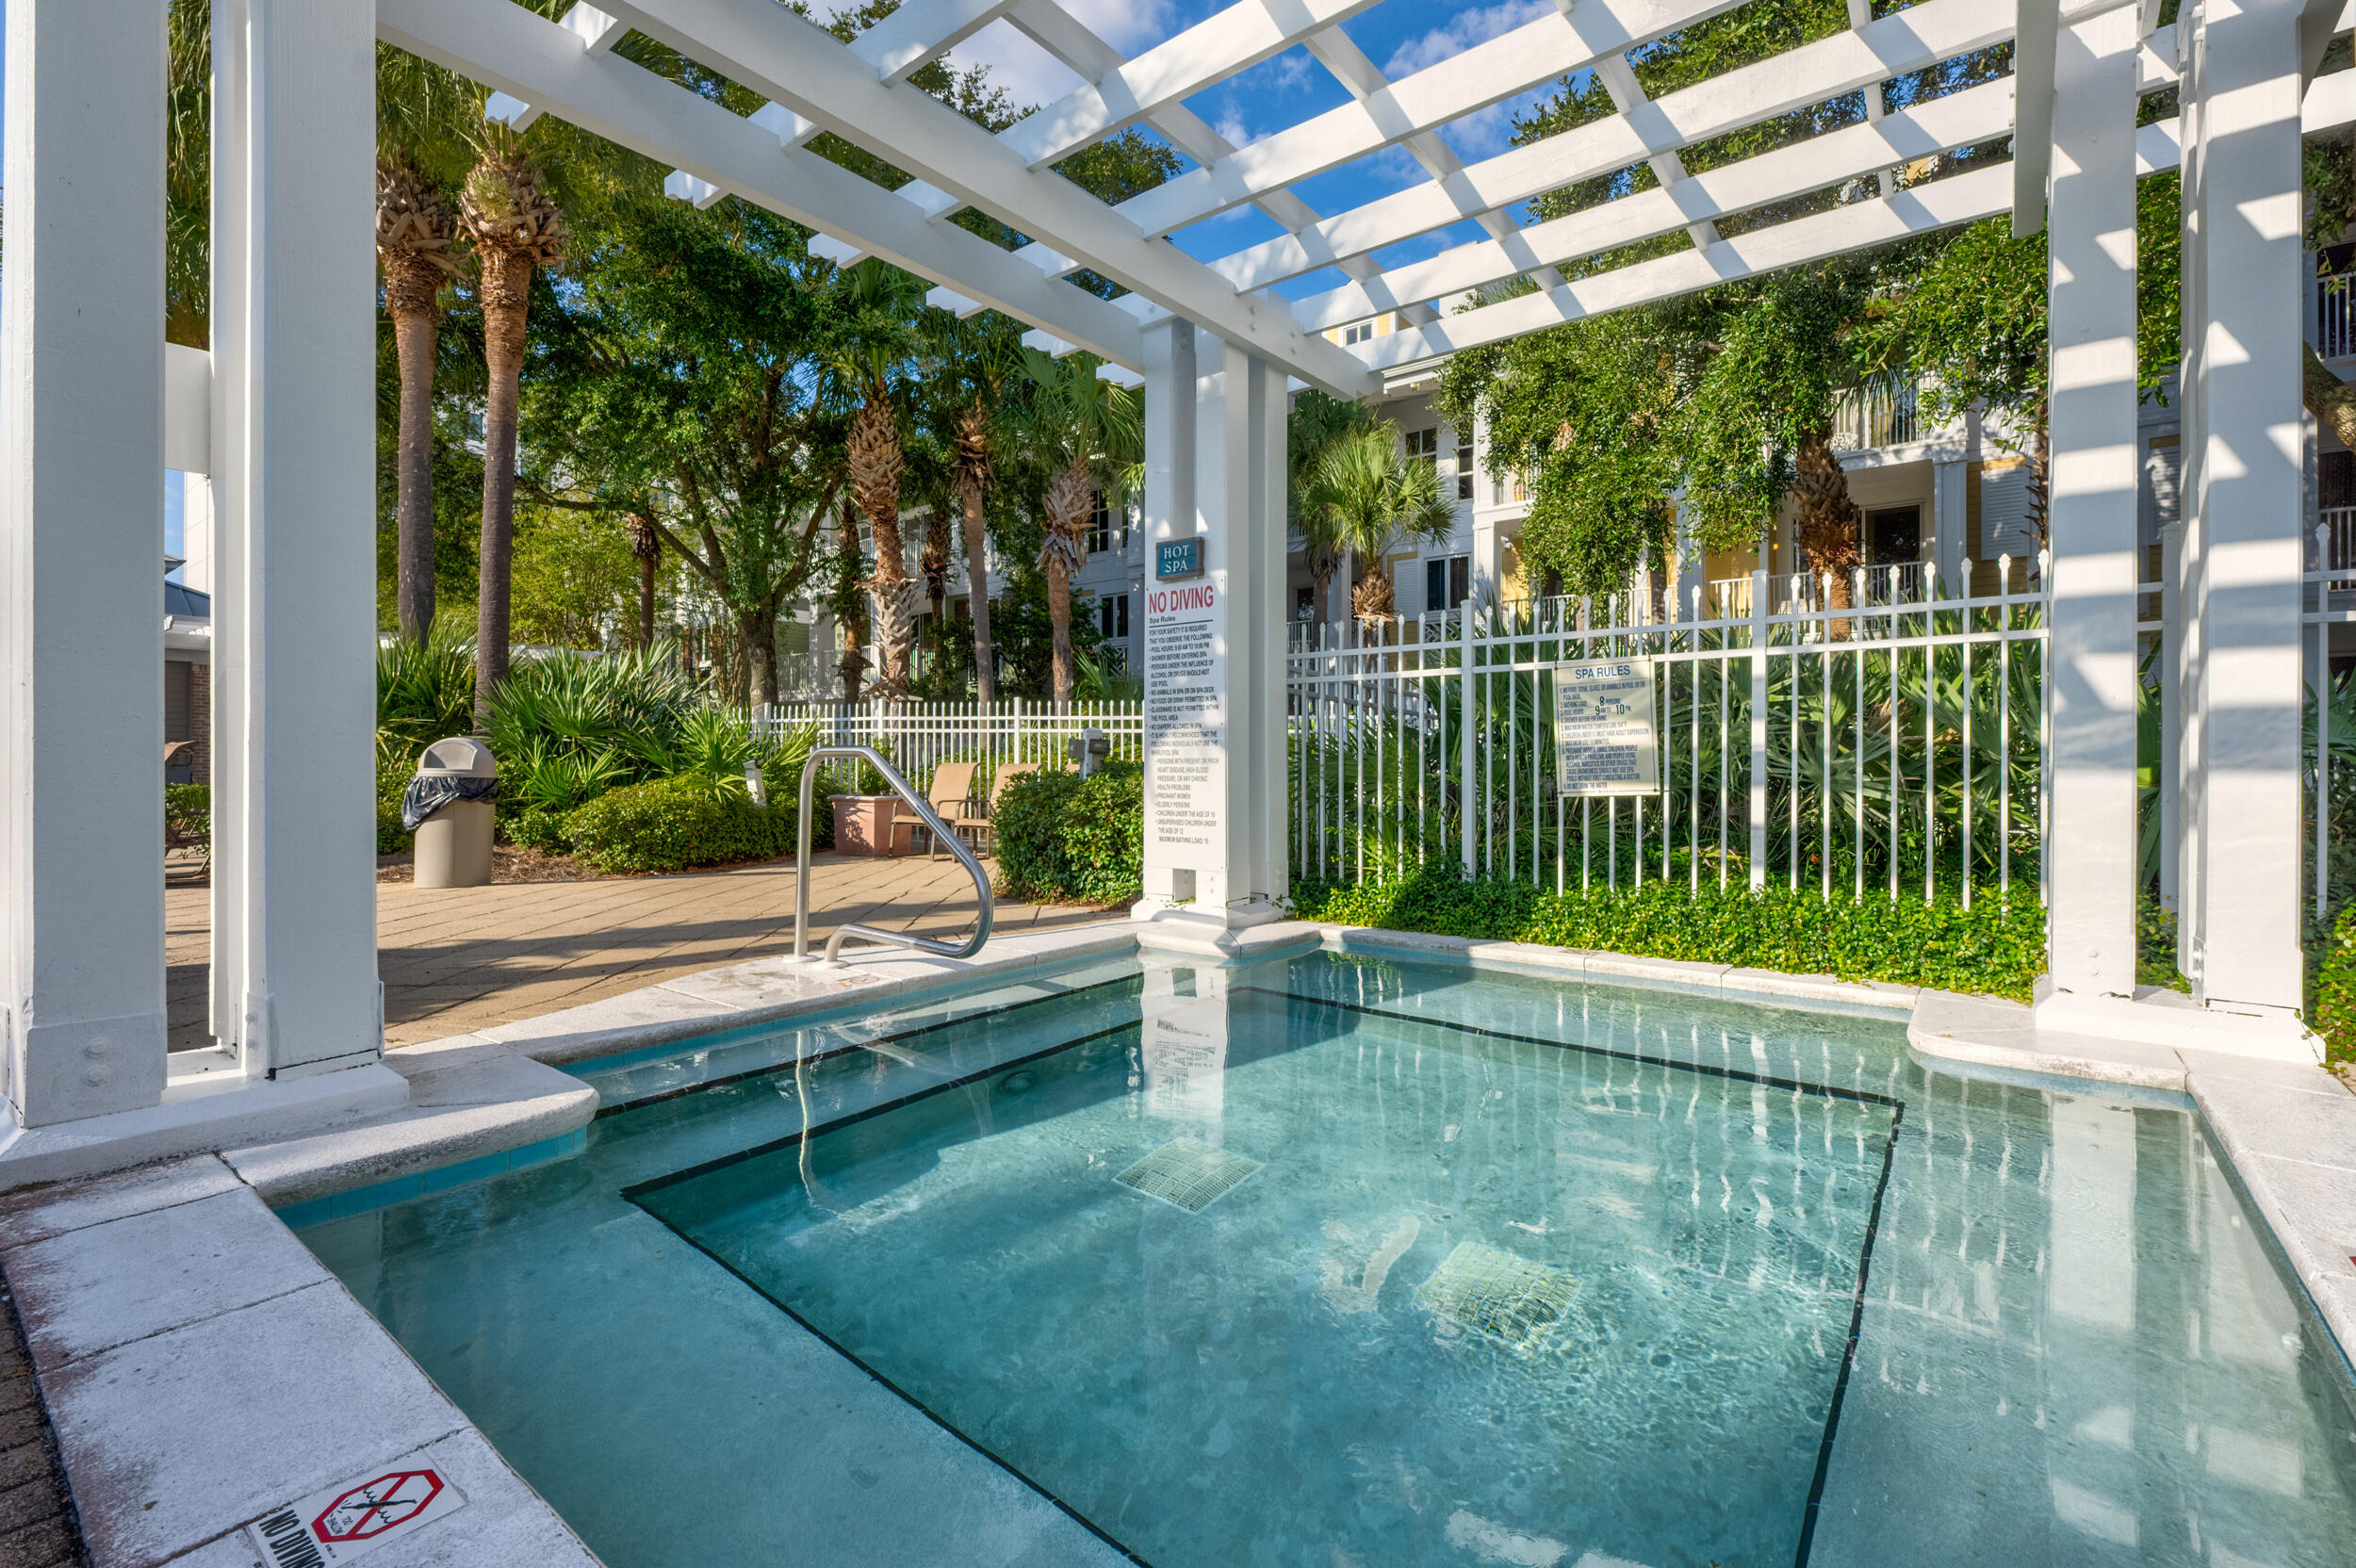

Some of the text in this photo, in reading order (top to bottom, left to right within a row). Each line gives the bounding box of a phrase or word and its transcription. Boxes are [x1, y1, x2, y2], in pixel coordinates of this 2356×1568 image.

[1164, 545, 1188, 559] HOT
[1165, 560, 1187, 573] SPA
[1149, 585, 1213, 613] NO DIVING
[1576, 664, 1630, 679] SPA RULES
[1600, 696, 1604, 706] 8
[1595, 706, 1600, 715] 9
[1616, 704, 1625, 714] 10
[258, 1509, 300, 1537] NO
